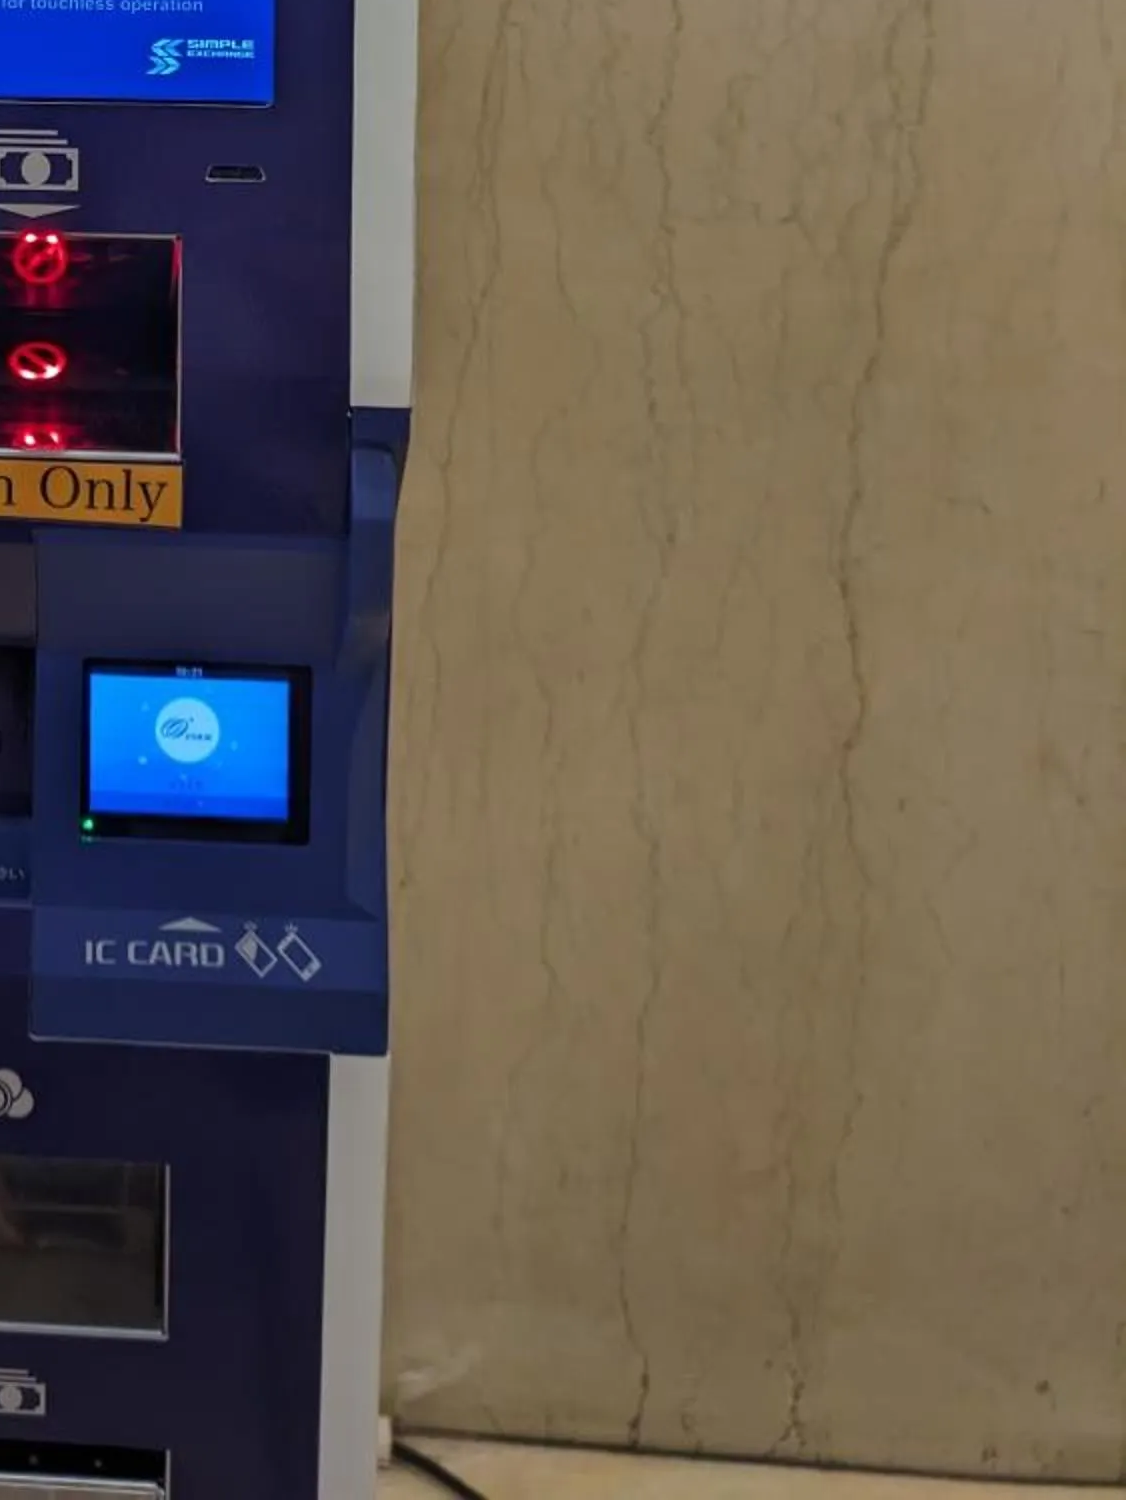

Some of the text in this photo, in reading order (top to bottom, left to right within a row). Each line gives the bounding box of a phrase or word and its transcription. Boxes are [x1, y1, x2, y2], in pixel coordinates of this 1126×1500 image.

[187, 39, 254, 49] SIMPLE
[40, 465, 167, 521] Only
[85, 939, 225, 968] IC CARD
